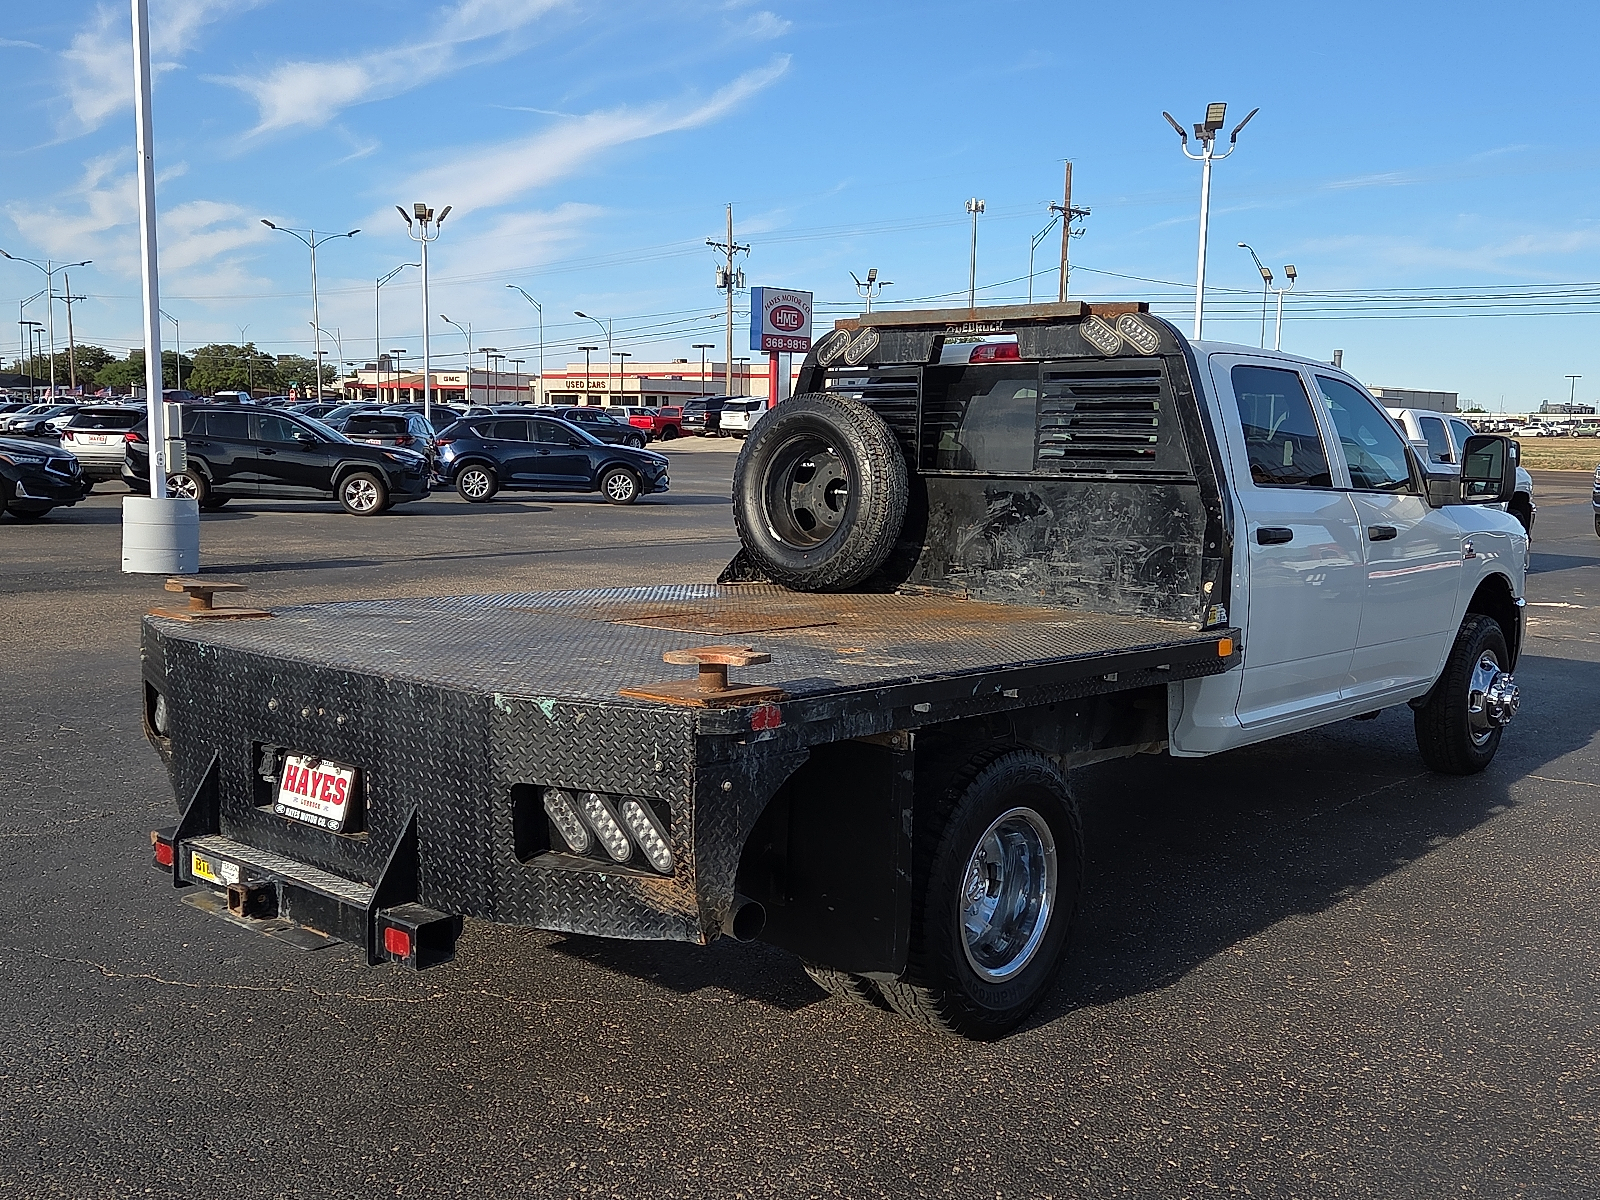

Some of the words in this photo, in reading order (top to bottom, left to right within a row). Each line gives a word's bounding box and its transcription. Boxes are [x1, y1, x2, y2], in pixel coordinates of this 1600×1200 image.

[765, 296, 780, 311] HAYES
[781, 294, 802, 306] MOTOR
[776, 309, 798, 328] HMC
[765, 337, 808, 350] 368-9815
[565, 380, 585, 389] USED
[587, 380, 606, 389] CARS
[283, 764, 347, 805] HAYES
